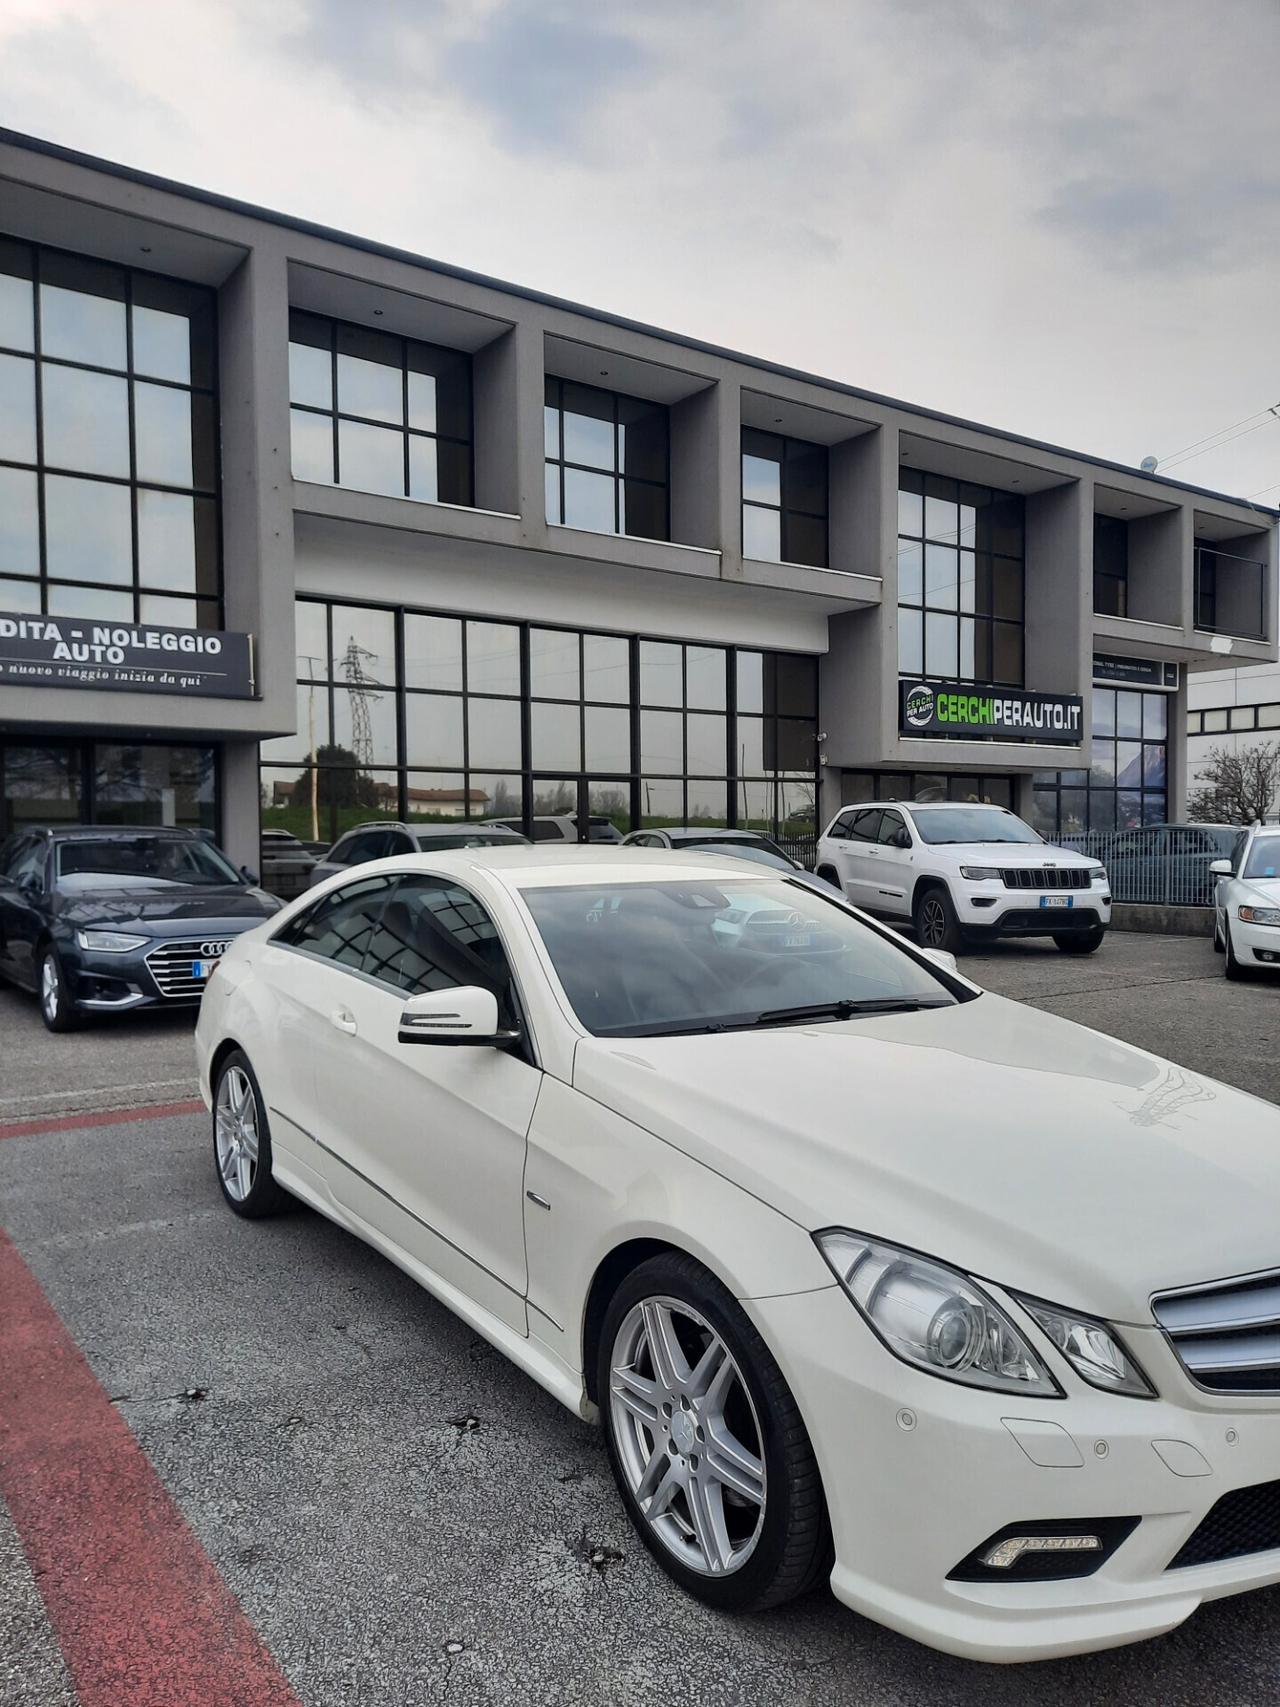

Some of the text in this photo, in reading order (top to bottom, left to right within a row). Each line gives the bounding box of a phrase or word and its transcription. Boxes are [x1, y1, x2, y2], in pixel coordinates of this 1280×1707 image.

[0, 619, 63, 641] DITA
[93, 627, 222, 654] NOLEGGIO
[52, 641, 125, 664] AUTO
[9, 665, 52, 676] nuovo
[58, 666, 109, 681] viaggio
[114, 670, 155, 683] inizia
[160, 674, 175, 684] da
[180, 675, 201, 688] qui
[936, 693, 1081, 730] CERCHIPERAUTO.IT
